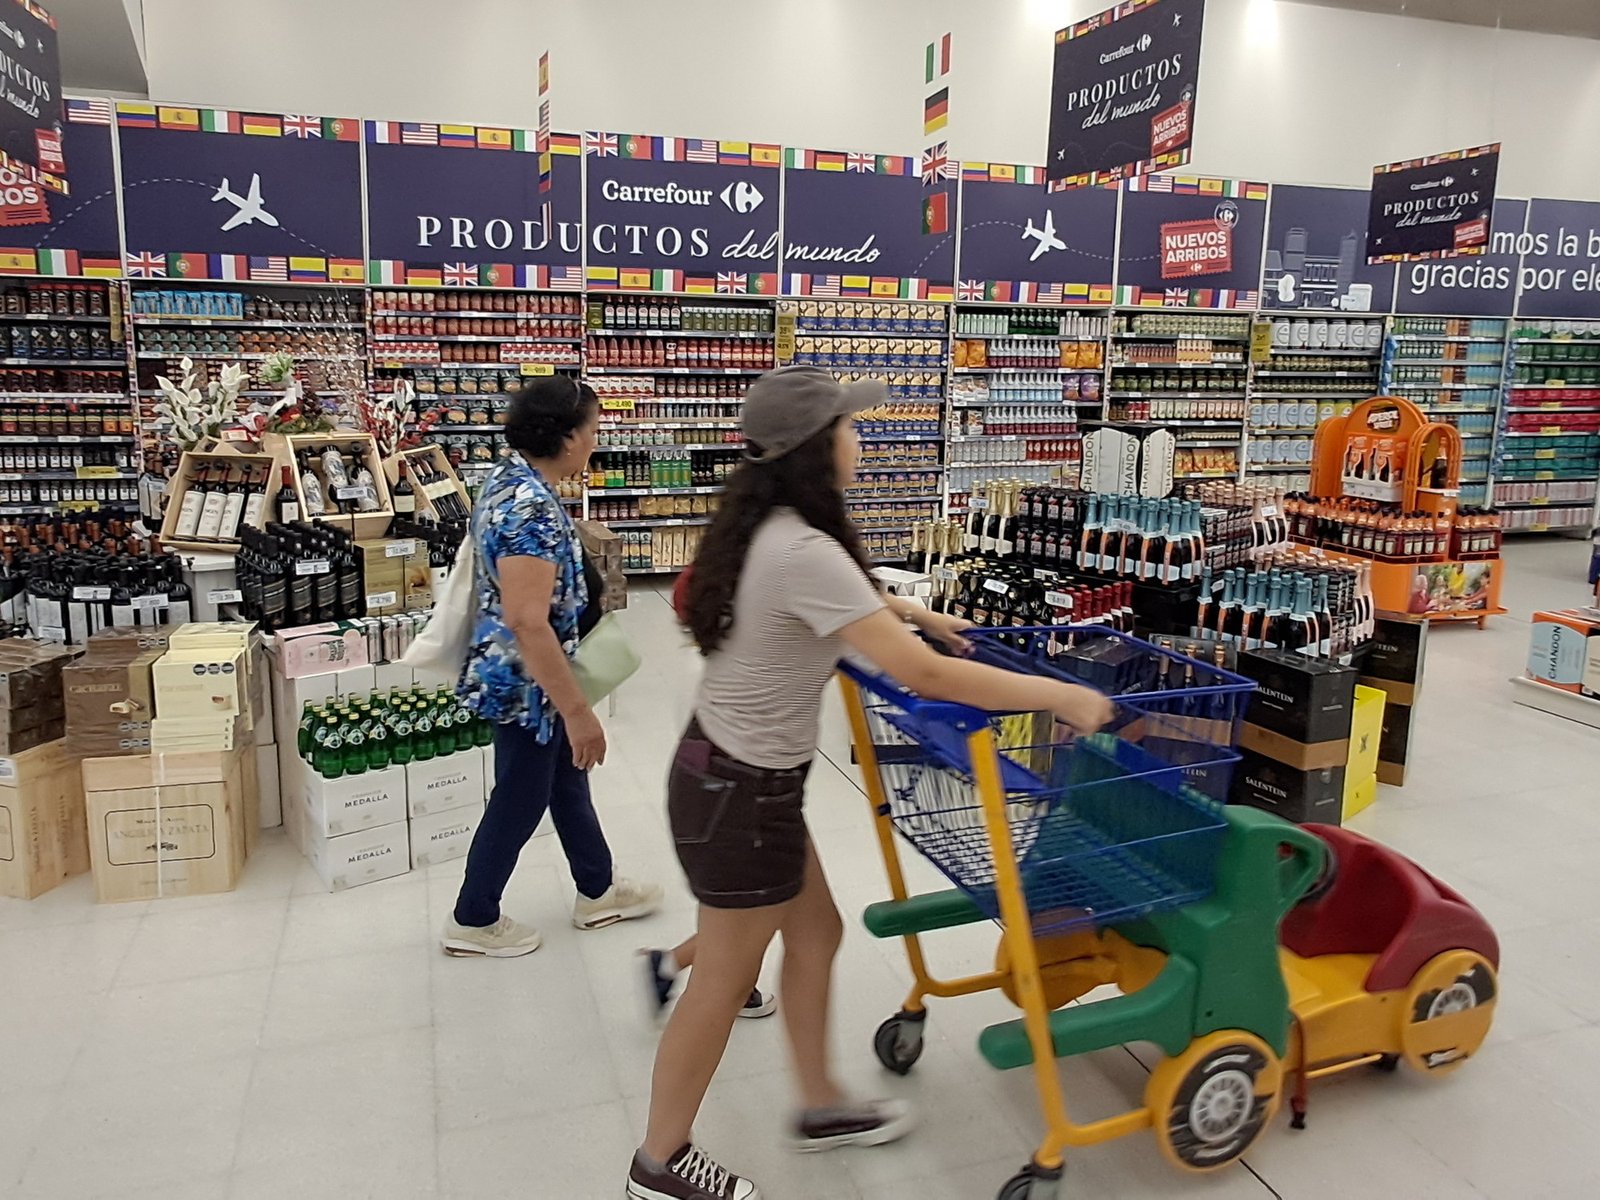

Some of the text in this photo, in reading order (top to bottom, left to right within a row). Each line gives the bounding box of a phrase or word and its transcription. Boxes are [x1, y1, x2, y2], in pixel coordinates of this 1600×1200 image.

[1099, 44, 1135, 65] Carrefour
[1066, 53, 1182, 111] PRODUCTOS
[1081, 82, 1161, 130] del mundo
[1152, 120, 1188, 146] ARRIBOS
[1153, 109, 1188, 135] NUEVOS
[602, 179, 713, 206] Carrefour
[1383, 190, 1480, 217] PRODUCTOS
[417, 214, 881, 264] PRODUCTOS del mundo
[1165, 231, 1227, 250] NUEVOS
[1557, 226, 1579, 257] la
[1164, 245, 1228, 264] ARRIBOS
[1410, 259, 1510, 295] gracias
[1518, 267, 1567, 297] por
[1083, 431, 1095, 492] CHANDON
[1548, 625, 1562, 679] CHANDON
[1257, 686, 1294, 704] ALENTEIN
[427, 775, 468, 790] MEDALLA
[1245, 776, 1288, 798] SALENTEIN
[344, 793, 389, 809] MEDALLA
[430, 826, 471, 842] MEDALLA
[347, 847, 392, 864] MEDALLA
